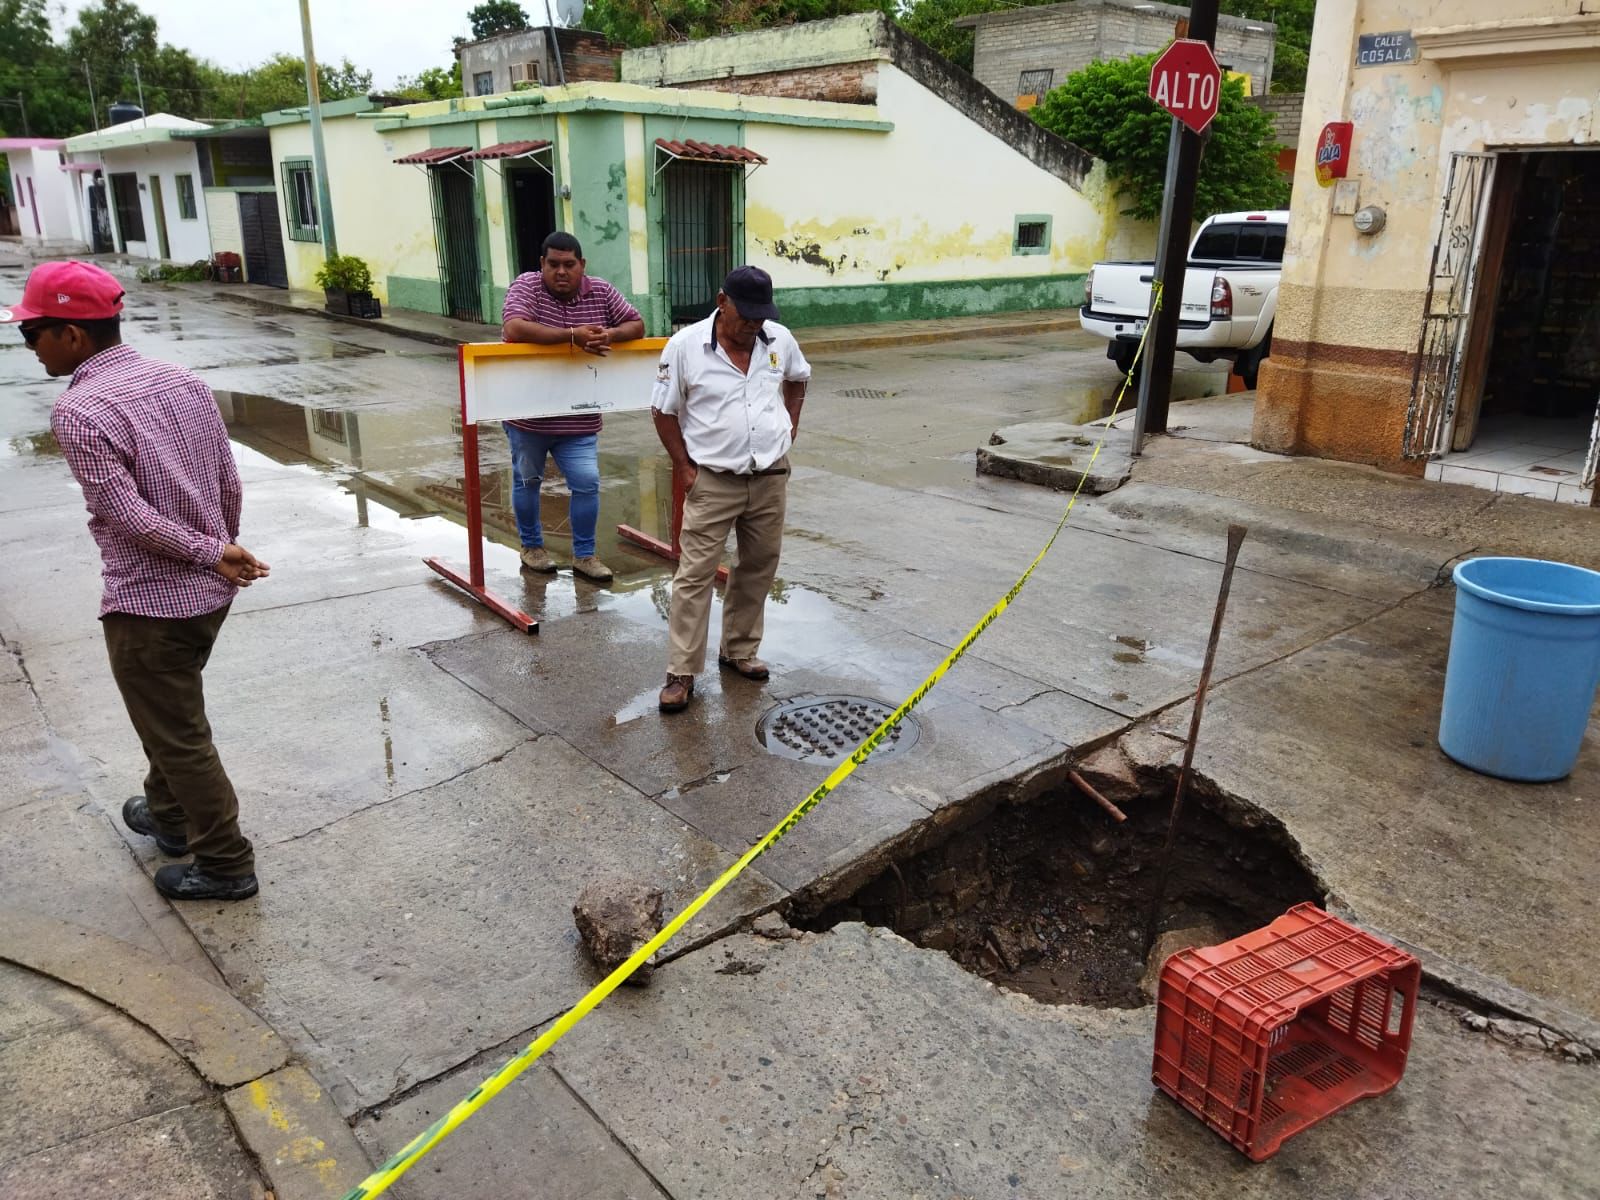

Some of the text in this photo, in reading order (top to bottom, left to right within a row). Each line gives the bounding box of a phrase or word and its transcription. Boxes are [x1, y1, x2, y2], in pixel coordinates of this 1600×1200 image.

[1374, 36, 1403, 48] CALLE
[1361, 48, 1412, 63] COSALA
[1155, 70, 1214, 111] ALTO
